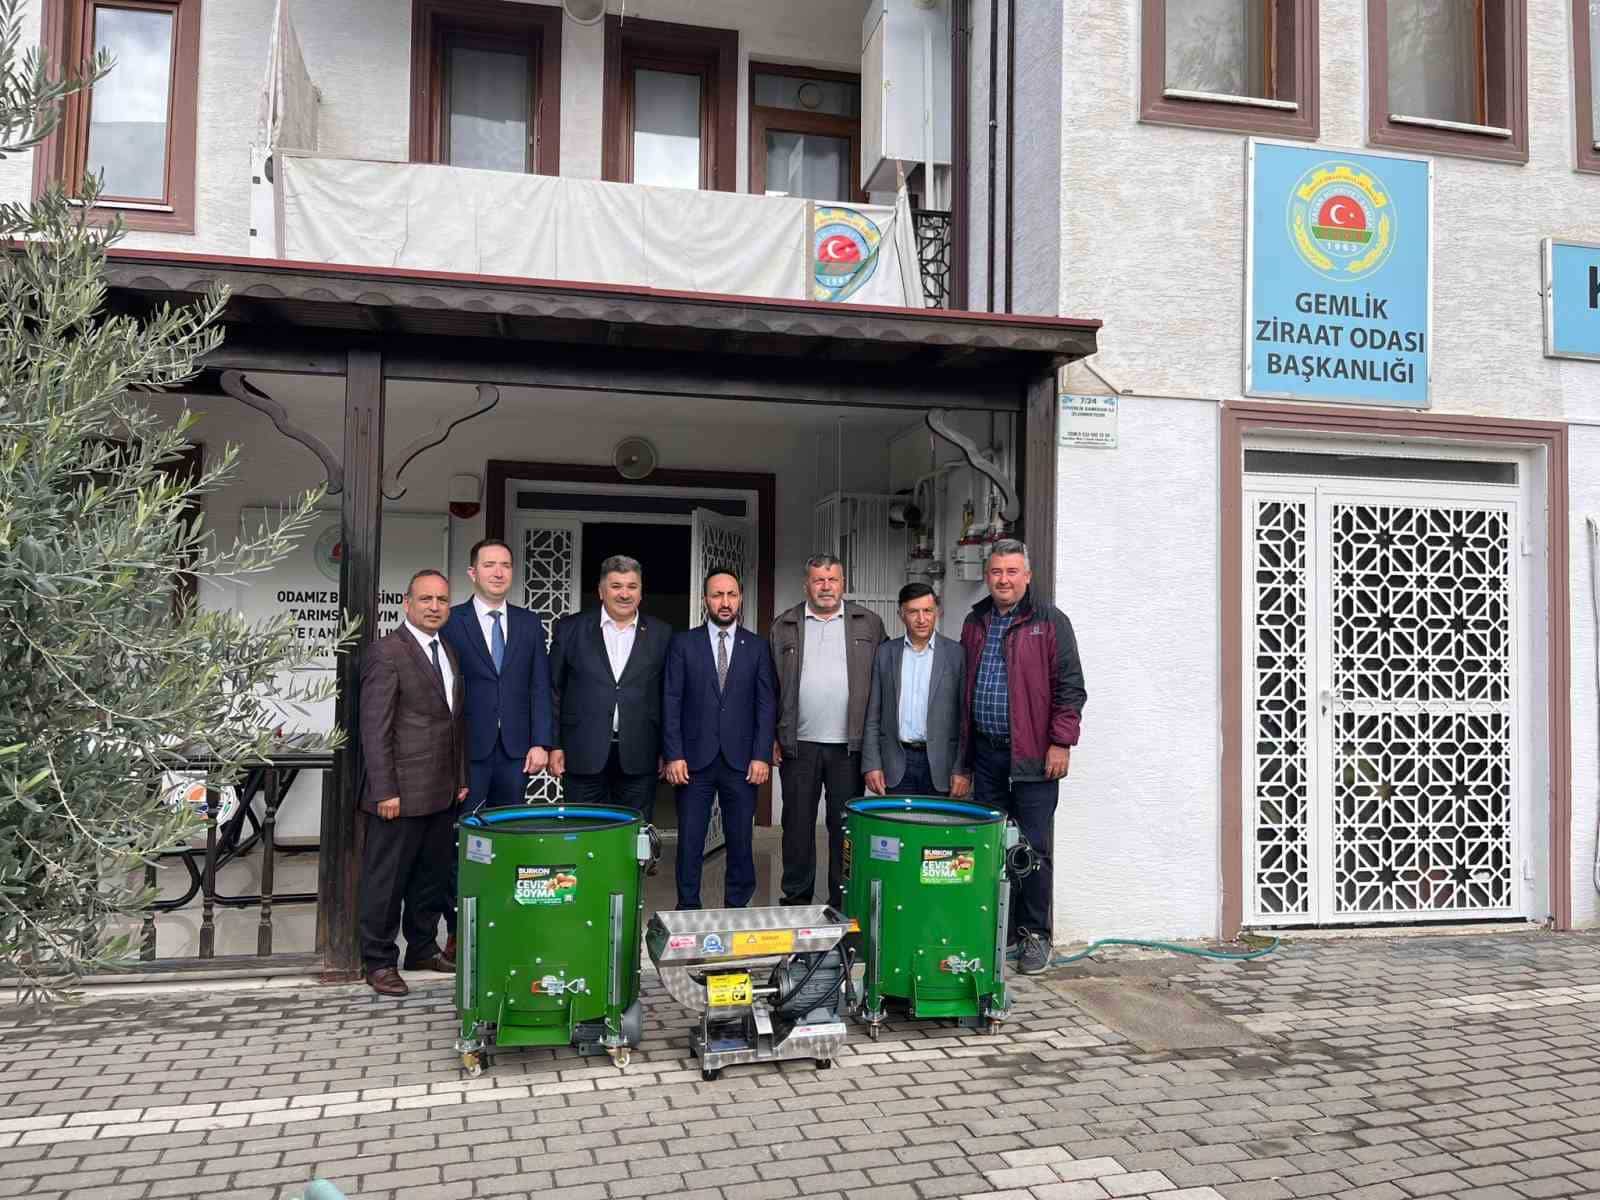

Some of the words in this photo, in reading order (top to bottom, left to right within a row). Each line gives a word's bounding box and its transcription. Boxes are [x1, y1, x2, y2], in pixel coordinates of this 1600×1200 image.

[1296, 292, 1388, 319] GEMLİK
[1256, 316, 1344, 346] ZİRAAT
[1350, 327, 1424, 353] ODASI
[1267, 353, 1414, 383] BAŞKANLIĞI
[277, 590, 327, 603] ODAMIZ
[290, 608, 340, 622] TARIMS
